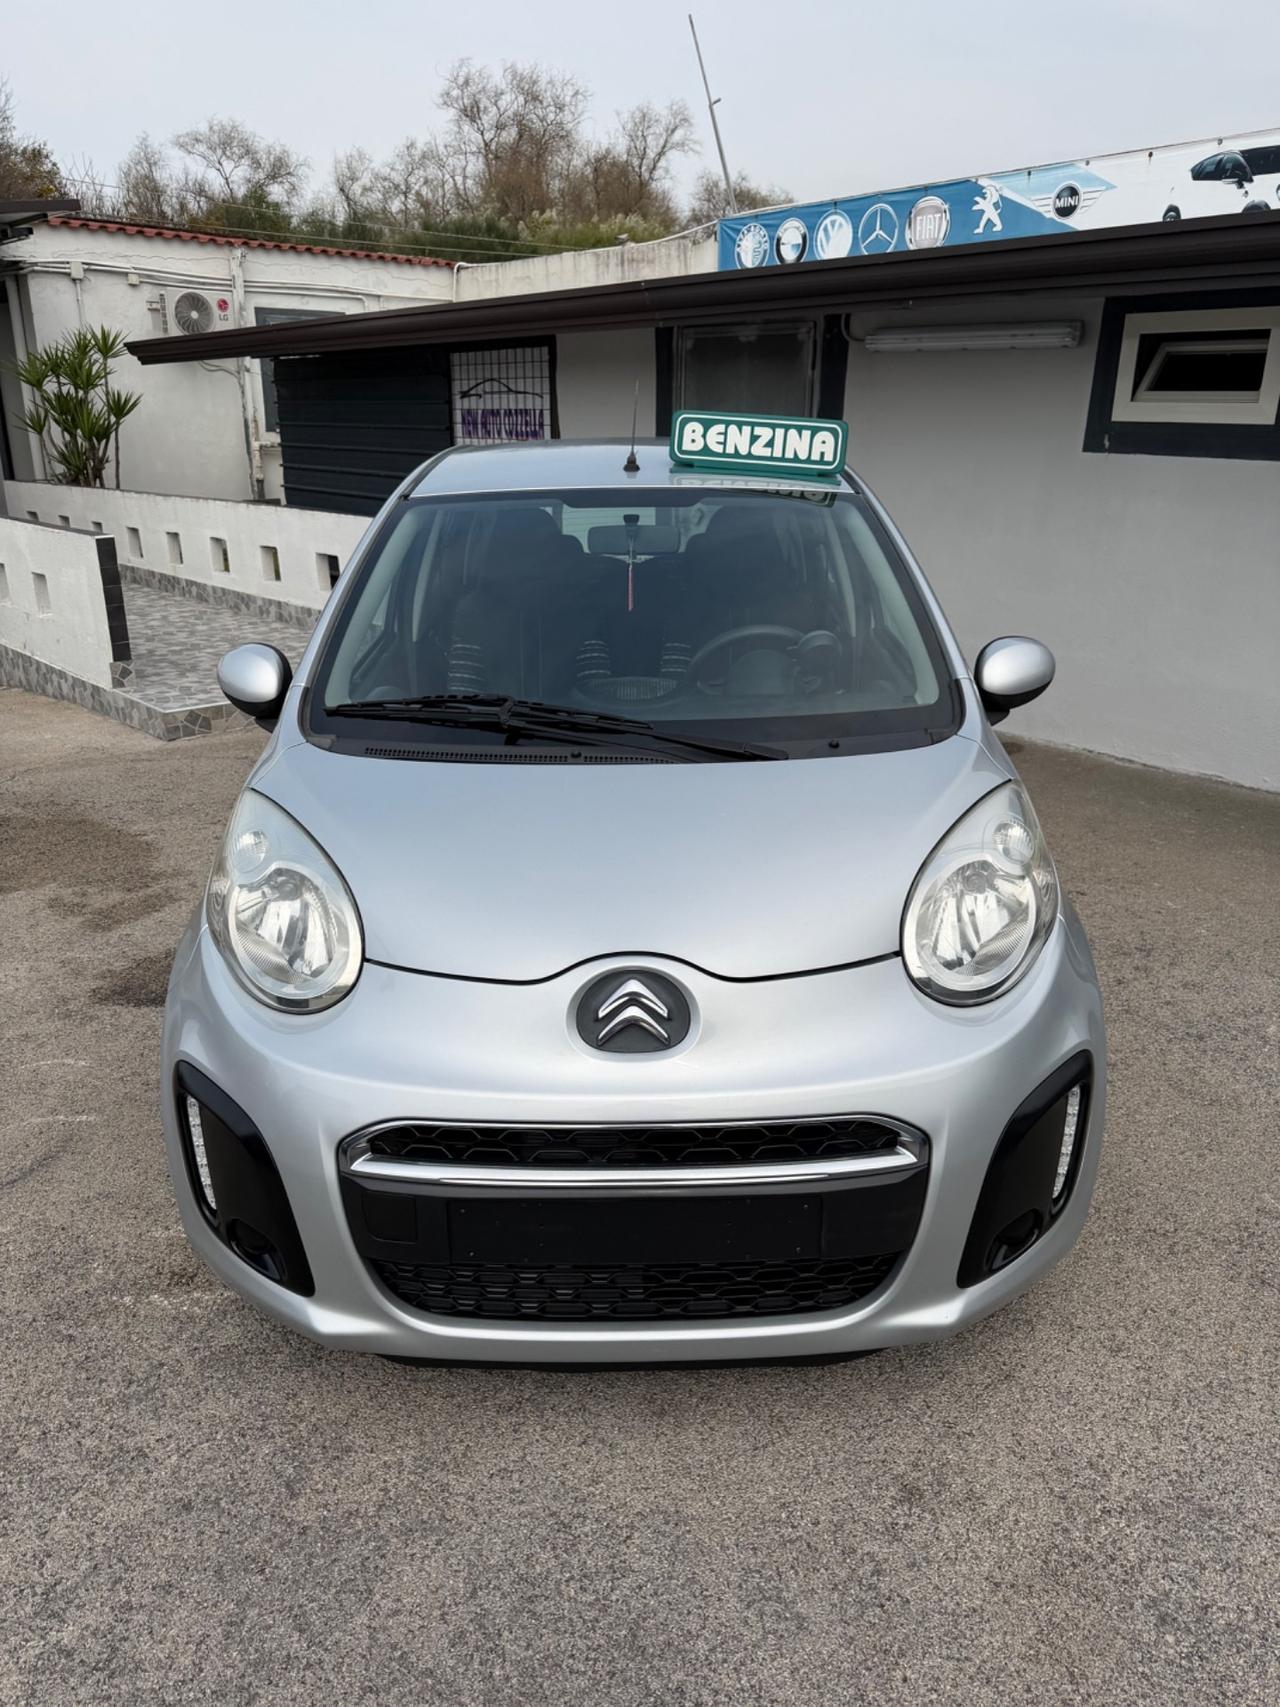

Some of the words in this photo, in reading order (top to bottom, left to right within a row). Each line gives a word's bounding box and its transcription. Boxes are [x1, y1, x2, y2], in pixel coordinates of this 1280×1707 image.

[1055, 195, 1079, 208] MINI
[916, 213, 941, 241] FIAT
[682, 421, 836, 461] BENZINA
